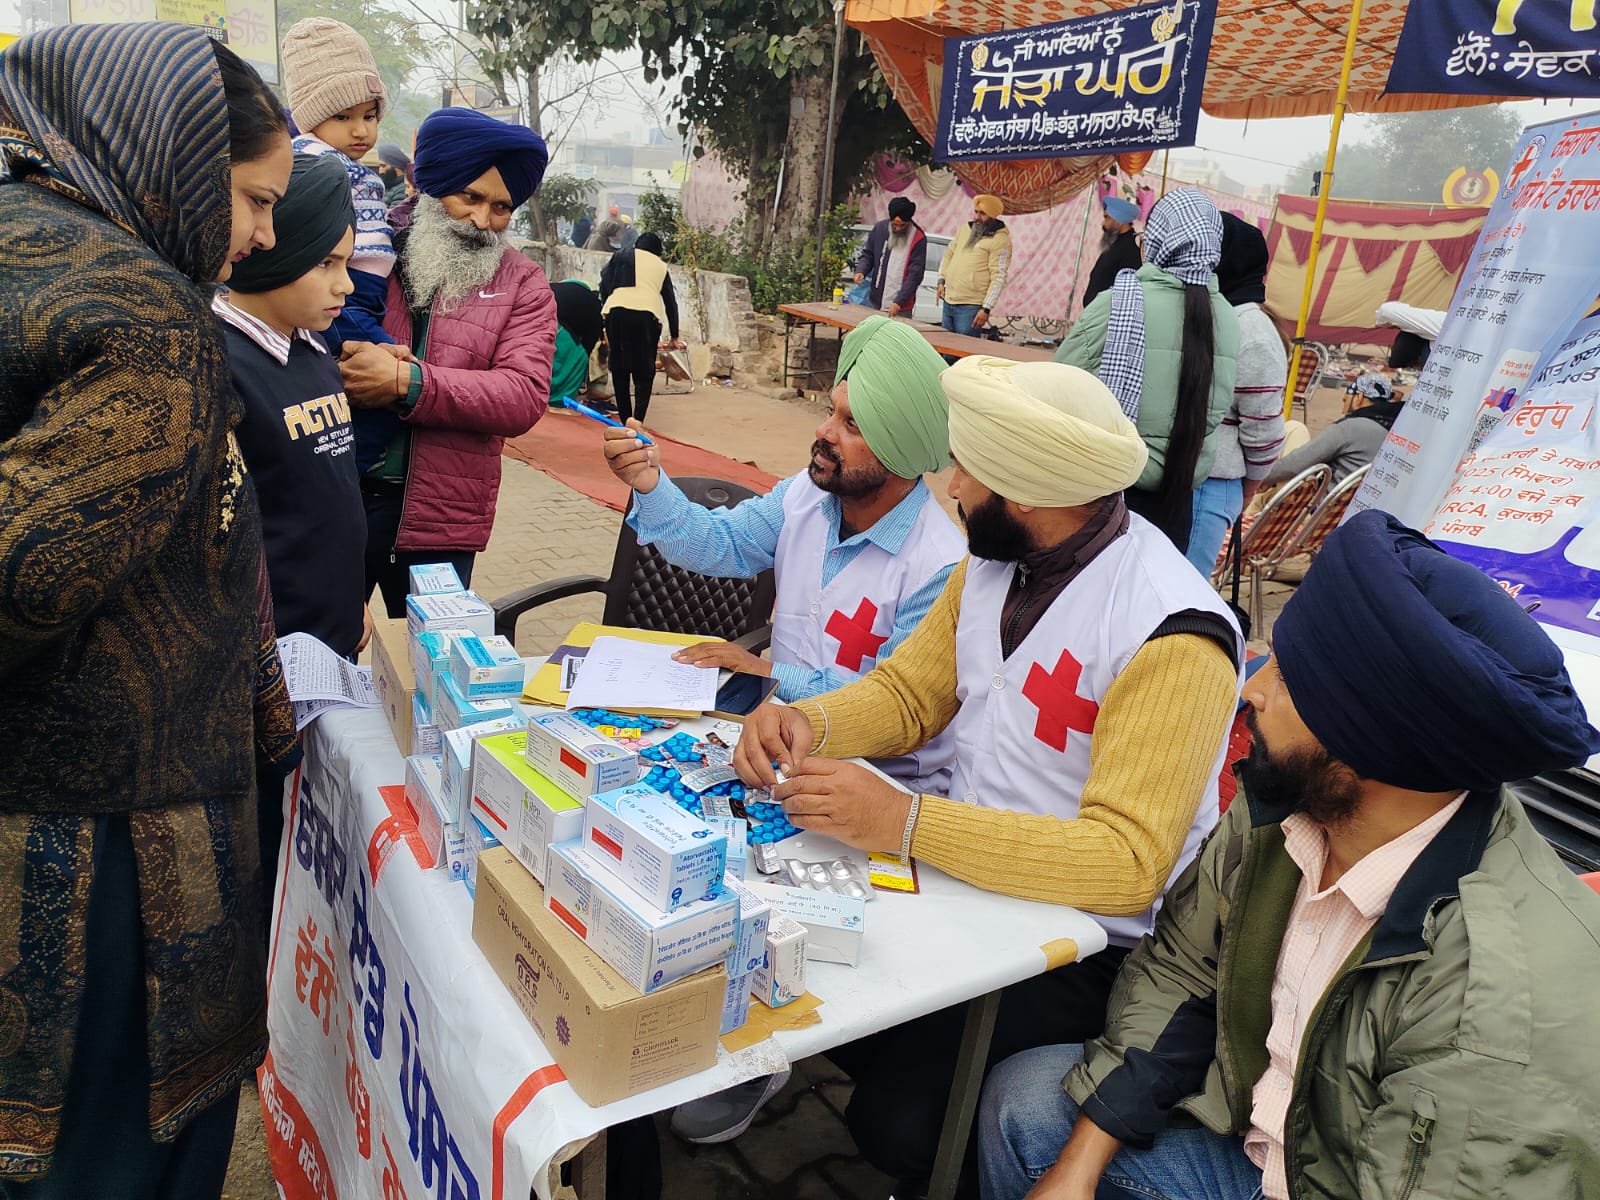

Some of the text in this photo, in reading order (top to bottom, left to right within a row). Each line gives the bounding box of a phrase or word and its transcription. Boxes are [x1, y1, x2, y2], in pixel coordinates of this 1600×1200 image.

[1013, 38, 1036, 62] ਜੀ
[1503, 41, 1596, 79] ਸੇਵਕ
[970, 33, 1188, 112] ਜੋੜਾ ਘਰ
[1462, 467, 1500, 478] 025
[1470, 484, 1512, 499] 4:00
[1517, 488, 1547, 504] ਵਜੇ
[1442, 519, 1486, 537] ਪੰਜਾਬ
[676, 861, 696, 873] Tablets
[497, 904, 511, 929] ORAL
[511, 921, 547, 971] REHYDRATION
[517, 963, 538, 999] ORS
